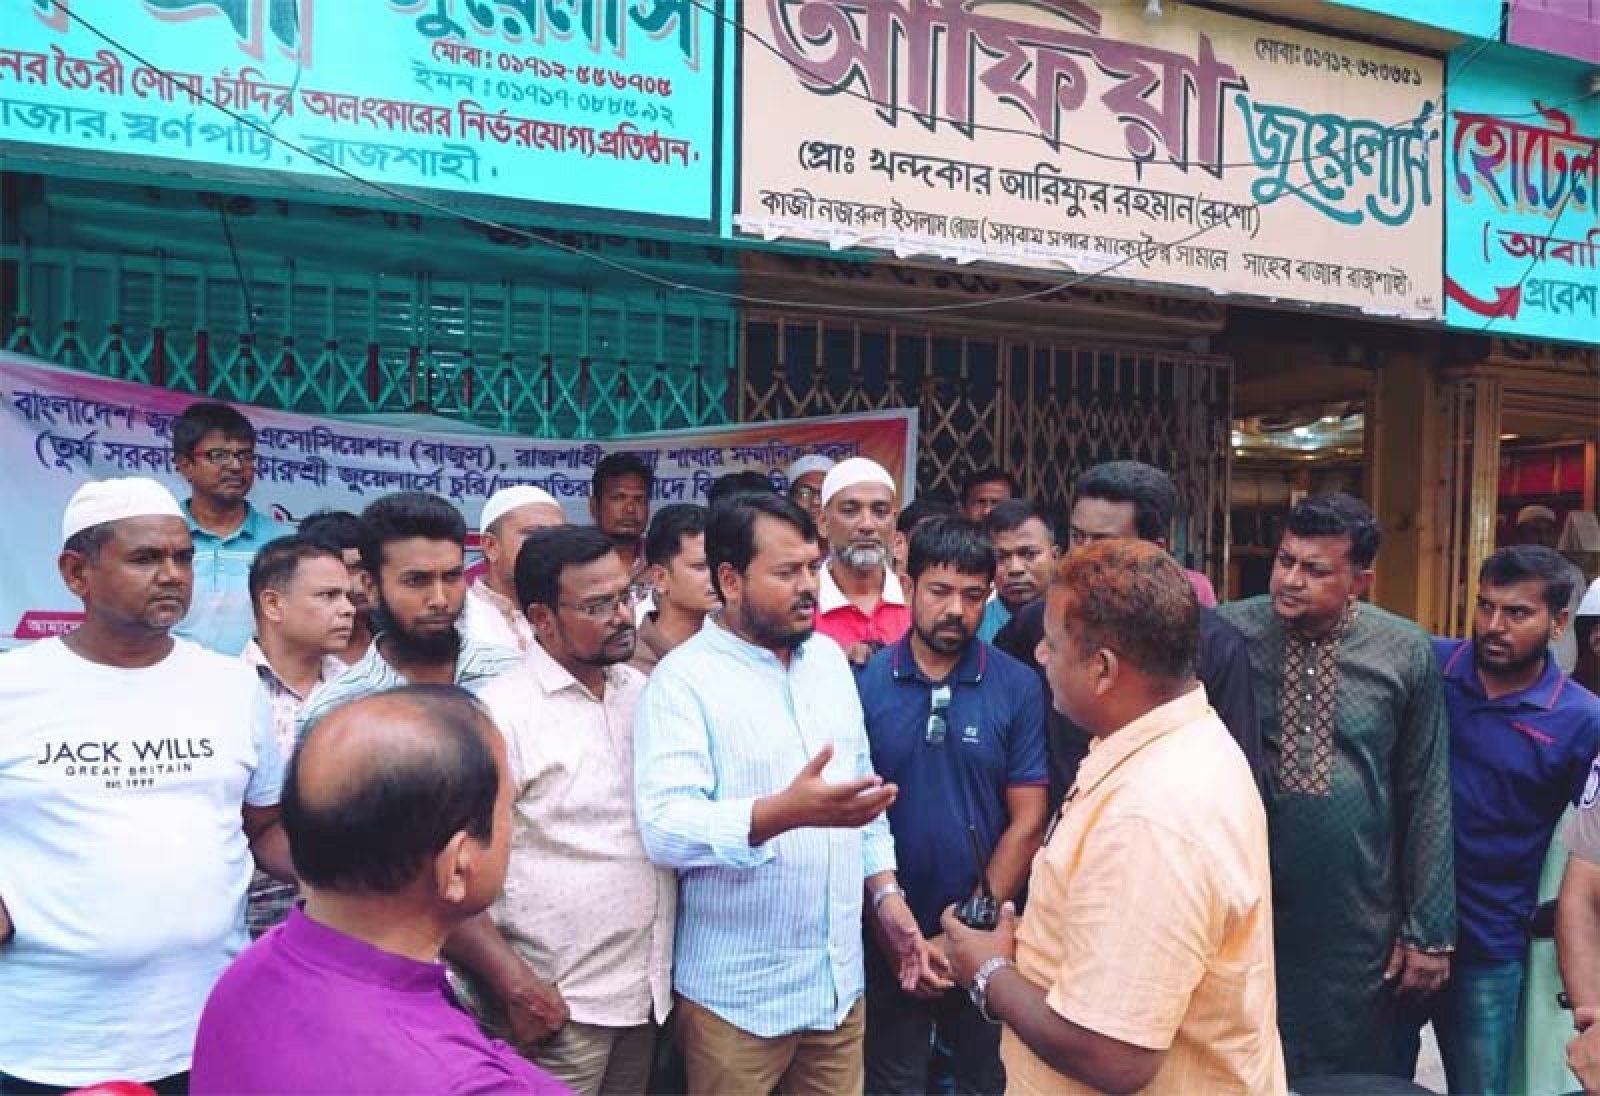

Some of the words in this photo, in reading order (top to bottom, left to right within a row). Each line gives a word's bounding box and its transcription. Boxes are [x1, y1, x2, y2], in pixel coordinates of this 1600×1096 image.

[50, 43, 125, 96] তৈরী
[300, 89, 453, 137] অলংকারের
[766, 0, 1249, 182] আফিয়া
[869, 148, 993, 195] খন্দকার
[999, 162, 1110, 218] আরিফুর
[1236, 95, 1439, 226] জুয়েলার্স
[1452, 99, 1600, 219] হোটেল
[759, 188, 817, 221] কাজী
[890, 197, 948, 238] ইসলাম
[1523, 277, 1598, 317] প্রবেশ
[12, 390, 135, 430] বাংলাদেশ
[514, 443, 607, 470] রাজশাহী
[103, 442, 175, 475] সরকা
[37, 741, 122, 765] JACK
[131, 738, 215, 762] WILLS
[65, 765, 121, 777] GREAT
[129, 762, 193, 776] BRITAIN
